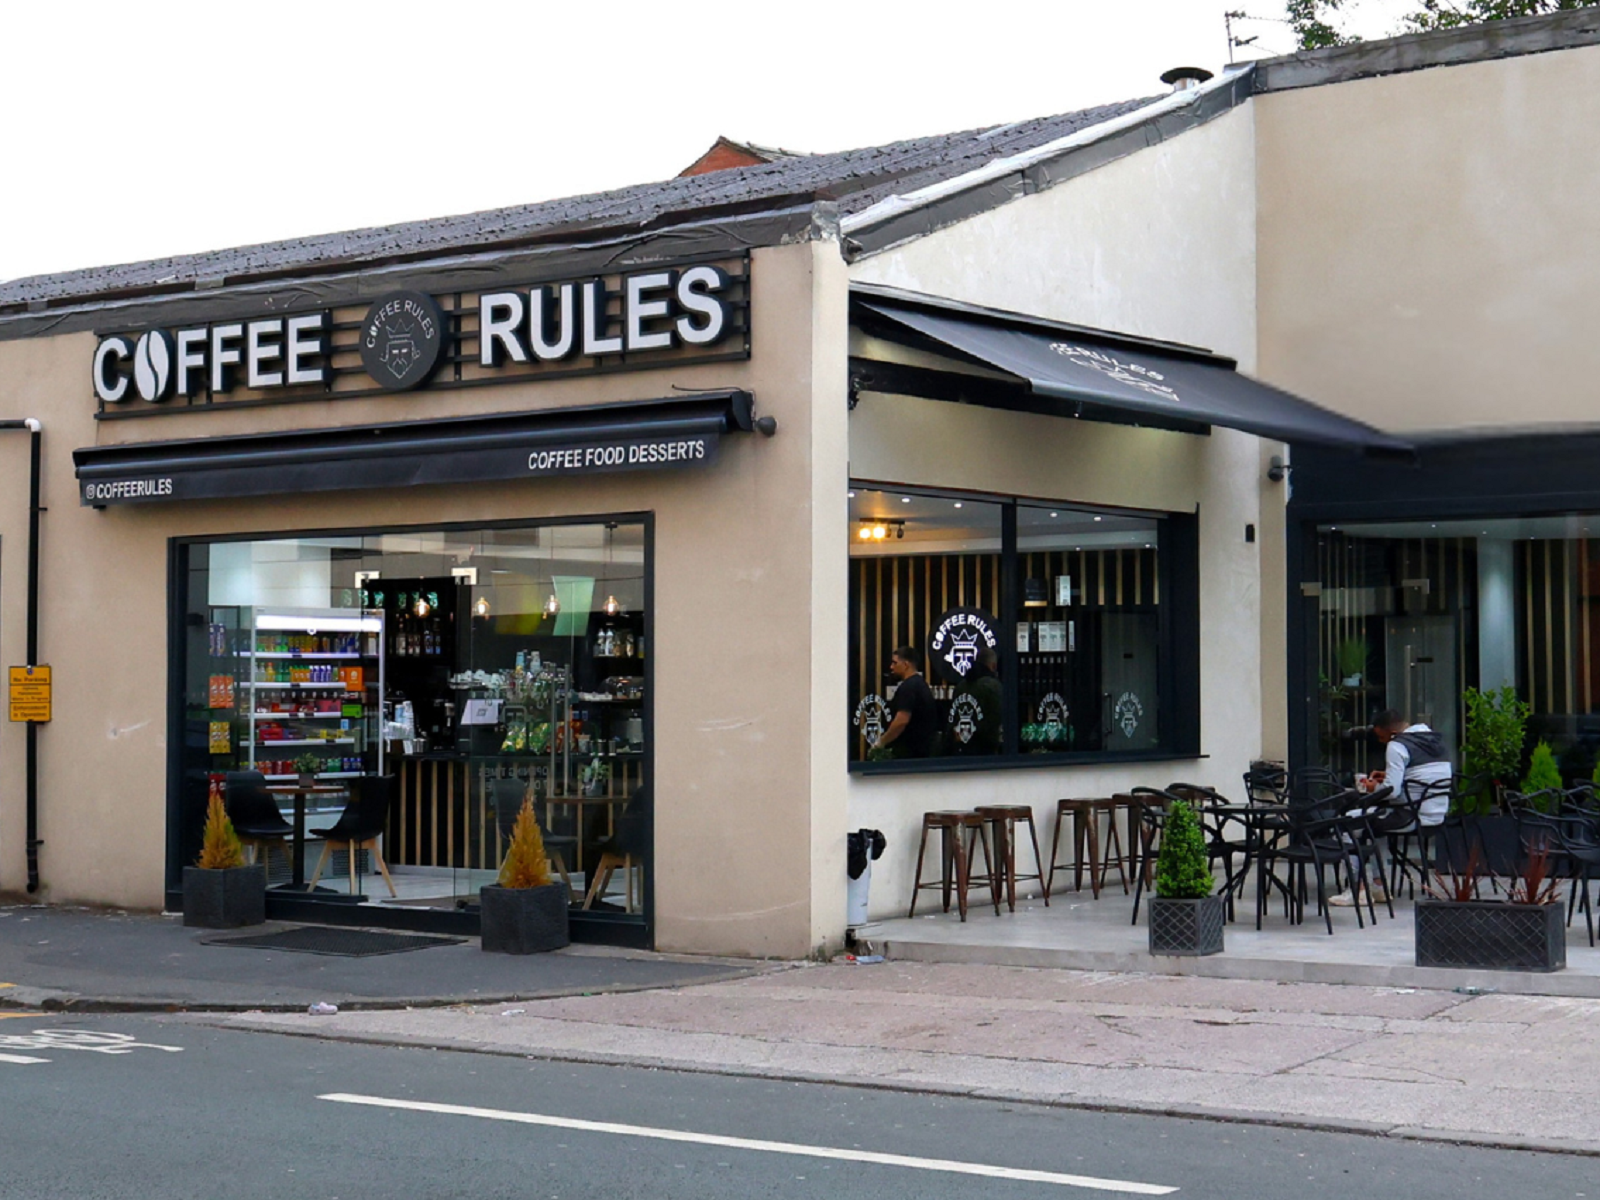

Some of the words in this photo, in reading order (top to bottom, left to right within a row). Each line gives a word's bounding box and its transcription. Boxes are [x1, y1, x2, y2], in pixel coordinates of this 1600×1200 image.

[93, 314, 324, 404] COFFEE
[480, 265, 725, 367] RULES
[366, 299, 401, 348] COFFEE
[404, 299, 435, 339] RULES
[528, 448, 582, 470] COFFEE
[585, 446, 625, 466] FOOD
[628, 439, 705, 464] DESSERTS
[932, 613, 966, 650] COFFEE
[967, 613, 997, 648] RULES
